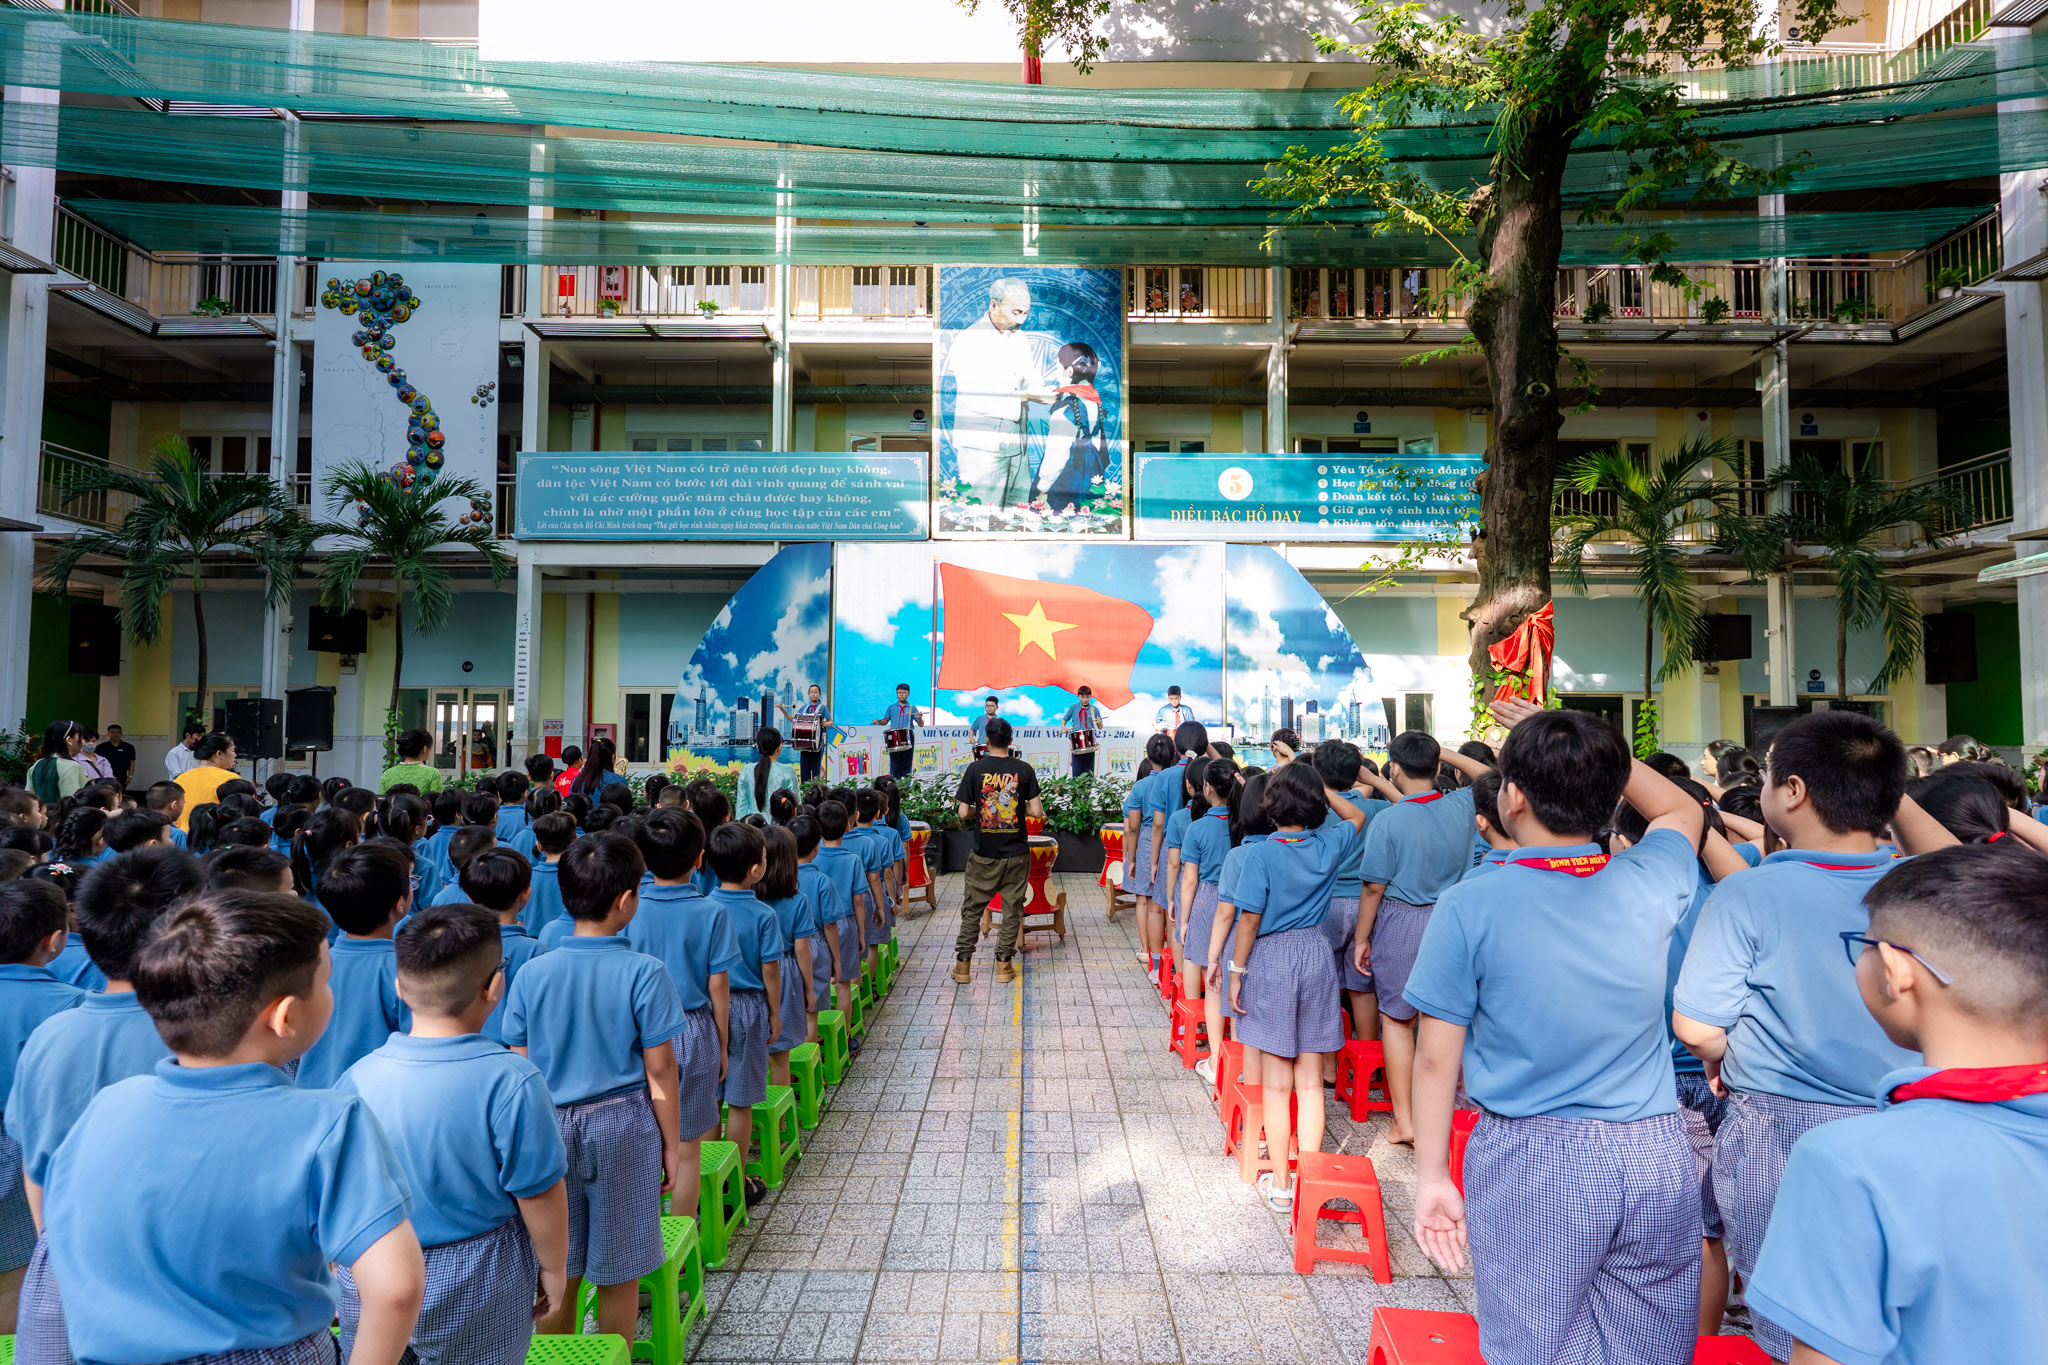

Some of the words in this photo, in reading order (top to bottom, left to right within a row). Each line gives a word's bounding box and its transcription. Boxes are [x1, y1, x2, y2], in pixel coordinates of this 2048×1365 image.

[590, 464, 620, 475] sông
[624, 464, 652, 475] Việt
[656, 464, 686, 473] Nam
[690, 464, 705, 473] có
[709, 463, 730, 473] trở
[734, 464, 758, 473] nên
[762, 464, 788, 473] tươi
[791, 464, 816, 476] đẹp
[820, 464, 842, 476] hay
[847, 464, 892, 476] không,
[1332, 466, 1355, 474] Yêu
[536, 479, 561, 488] dân
[565, 479, 586, 489] tộc
[590, 479, 617, 489] Việt
[621, 479, 653, 488] Nam
[656, 479, 671, 488] có
[675, 479, 707, 488] bước
[710, 479, 728, 488] tới
[731, 479, 752, 488] đài
[756, 479, 784, 488] vinh
[787, 481, 827, 490] quang
[830, 477, 848, 488] để
[850, 479, 882, 488] sánh
[886, 479, 905, 488] vai
[1229, 474, 1243, 494] 5
[1332, 479, 1355, 489] Học
[569, 493, 589, 502] với
[593, 493, 615, 502] các
[618, 493, 659, 504] cường
[662, 492, 693, 504] quốc
[697, 493, 726, 502] năm
[729, 493, 761, 502] châu
[764, 494, 797, 504] được
[800, 494, 823, 504] hay
[827, 494, 872, 504] không,
[1332, 492, 1363, 501] Đoàn
[1367, 491, 1386, 501] kết
[1390, 492, 1410, 502] tốt,
[543, 508, 579, 517] chính
[583, 508, 595, 517] là
[599, 508, 625, 517] nhờ
[627, 508, 653, 518] một
[658, 506, 690, 518] phần
[694, 508, 715, 517] lớn
[718, 507, 728, 517] ở
[730, 508, 762, 518] công
[765, 508, 789, 518] học
[792, 508, 815, 519] tập
[818, 507, 841, 517] của
[845, 508, 868, 517] các
[1170, 504, 1207, 523] ĐIỀU
[1211, 506, 1241, 523] BÁC
[1245, 504, 1267, 523] HỒ
[1271, 510, 1302, 526] DẠY
[1332, 505, 1354, 514] Giữ
[1357, 506, 1376, 516] gìn
[1380, 506, 1393, 516] vệ
[1397, 506, 1422, 514] sinh
[1426, 506, 1451, 516] thật
[606, 521, 620, 529] Minh
[637, 521, 652, 530] trong
[834, 521, 847, 529] Nam
[1332, 518, 1372, 528] Khiêm
[1375, 518, 1398, 528] tốn,
[1402, 520, 1427, 529] thật
[981, 772, 1019, 788] PANDA
